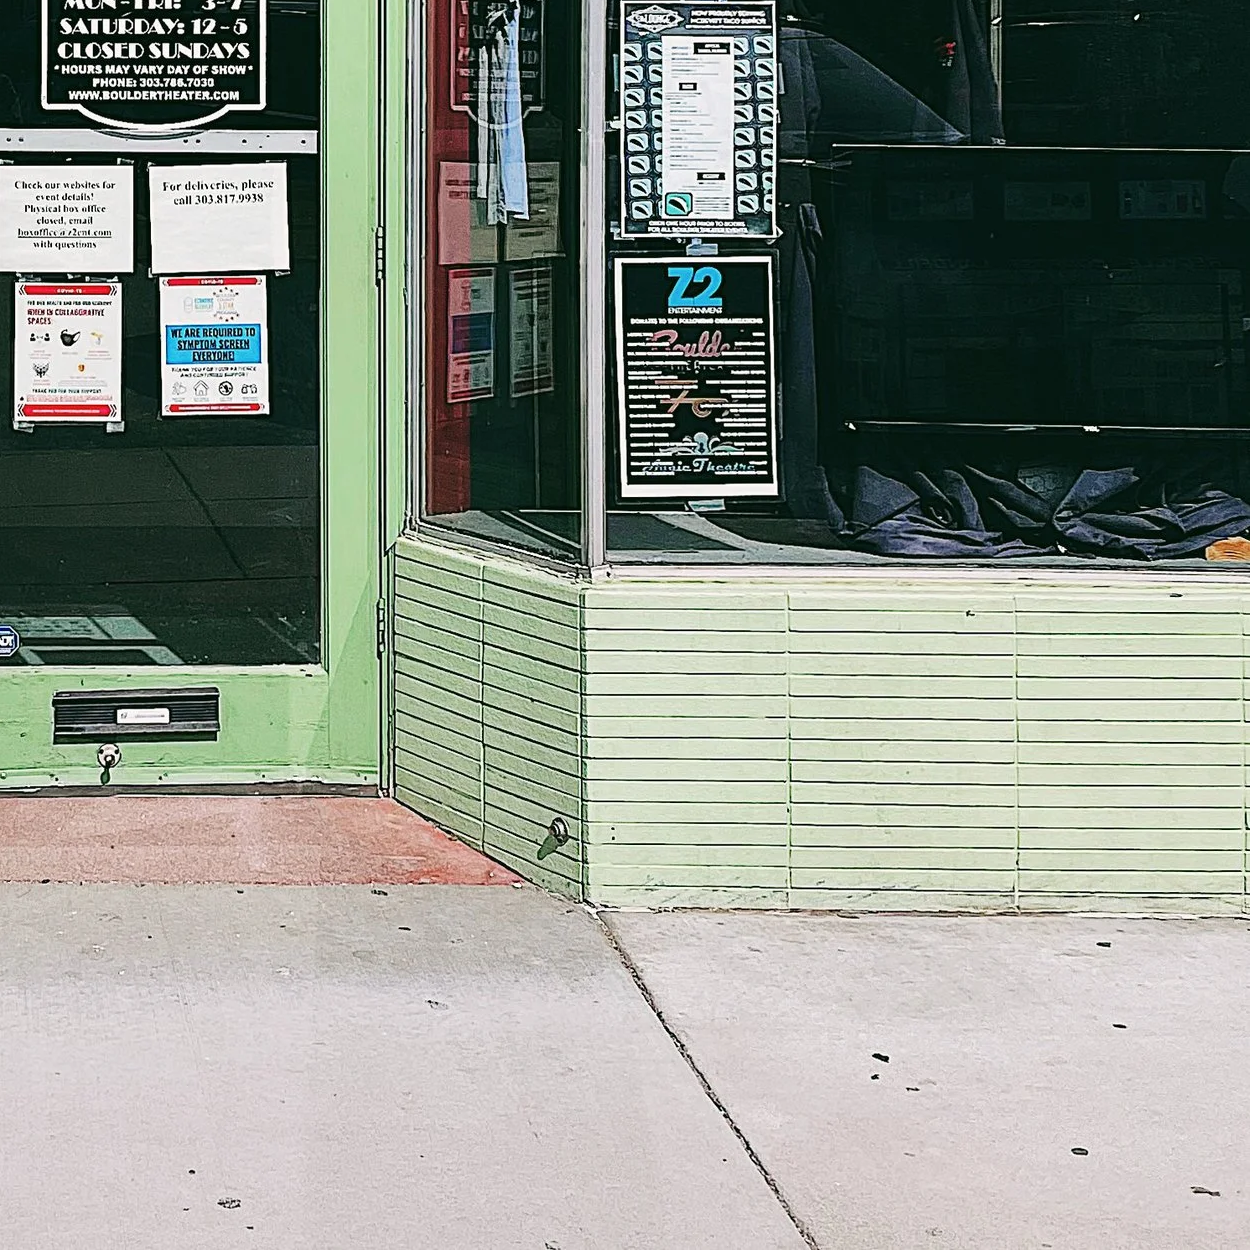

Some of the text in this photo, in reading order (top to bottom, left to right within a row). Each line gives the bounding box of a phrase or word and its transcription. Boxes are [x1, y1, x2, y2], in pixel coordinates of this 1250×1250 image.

[59, 18, 186, 35] SATURDAY:
[57, 42, 250, 60] CLOSED SUNDAYS
[105, 65, 130, 75] MAY
[133, 65, 165, 75] VARY
[167, 65, 190, 75] DAY
[193, 65, 209, 75] OF
[92, 78, 215, 88] PHONE: 303.786.7030
[68, 90, 240, 101] WWW.BOULDERTHEATER.COM
[14, 181, 116, 189] Check our websites for
[162, 179, 274, 191] For deliveries, please
[35, 193, 94, 201] event details!
[173, 193, 264, 205] call 303.817.9938
[24, 205, 106, 214] Physical box office
[36, 217, 93, 225] closed, email
[33, 240, 97, 249] with questions
[668, 266, 722, 307] Z2
[27, 317, 51, 325] SPACES
[171, 328, 256, 338] WE ARE REQUIRED TO
[177, 339, 250, 350] SYMPTOM SCREEN
